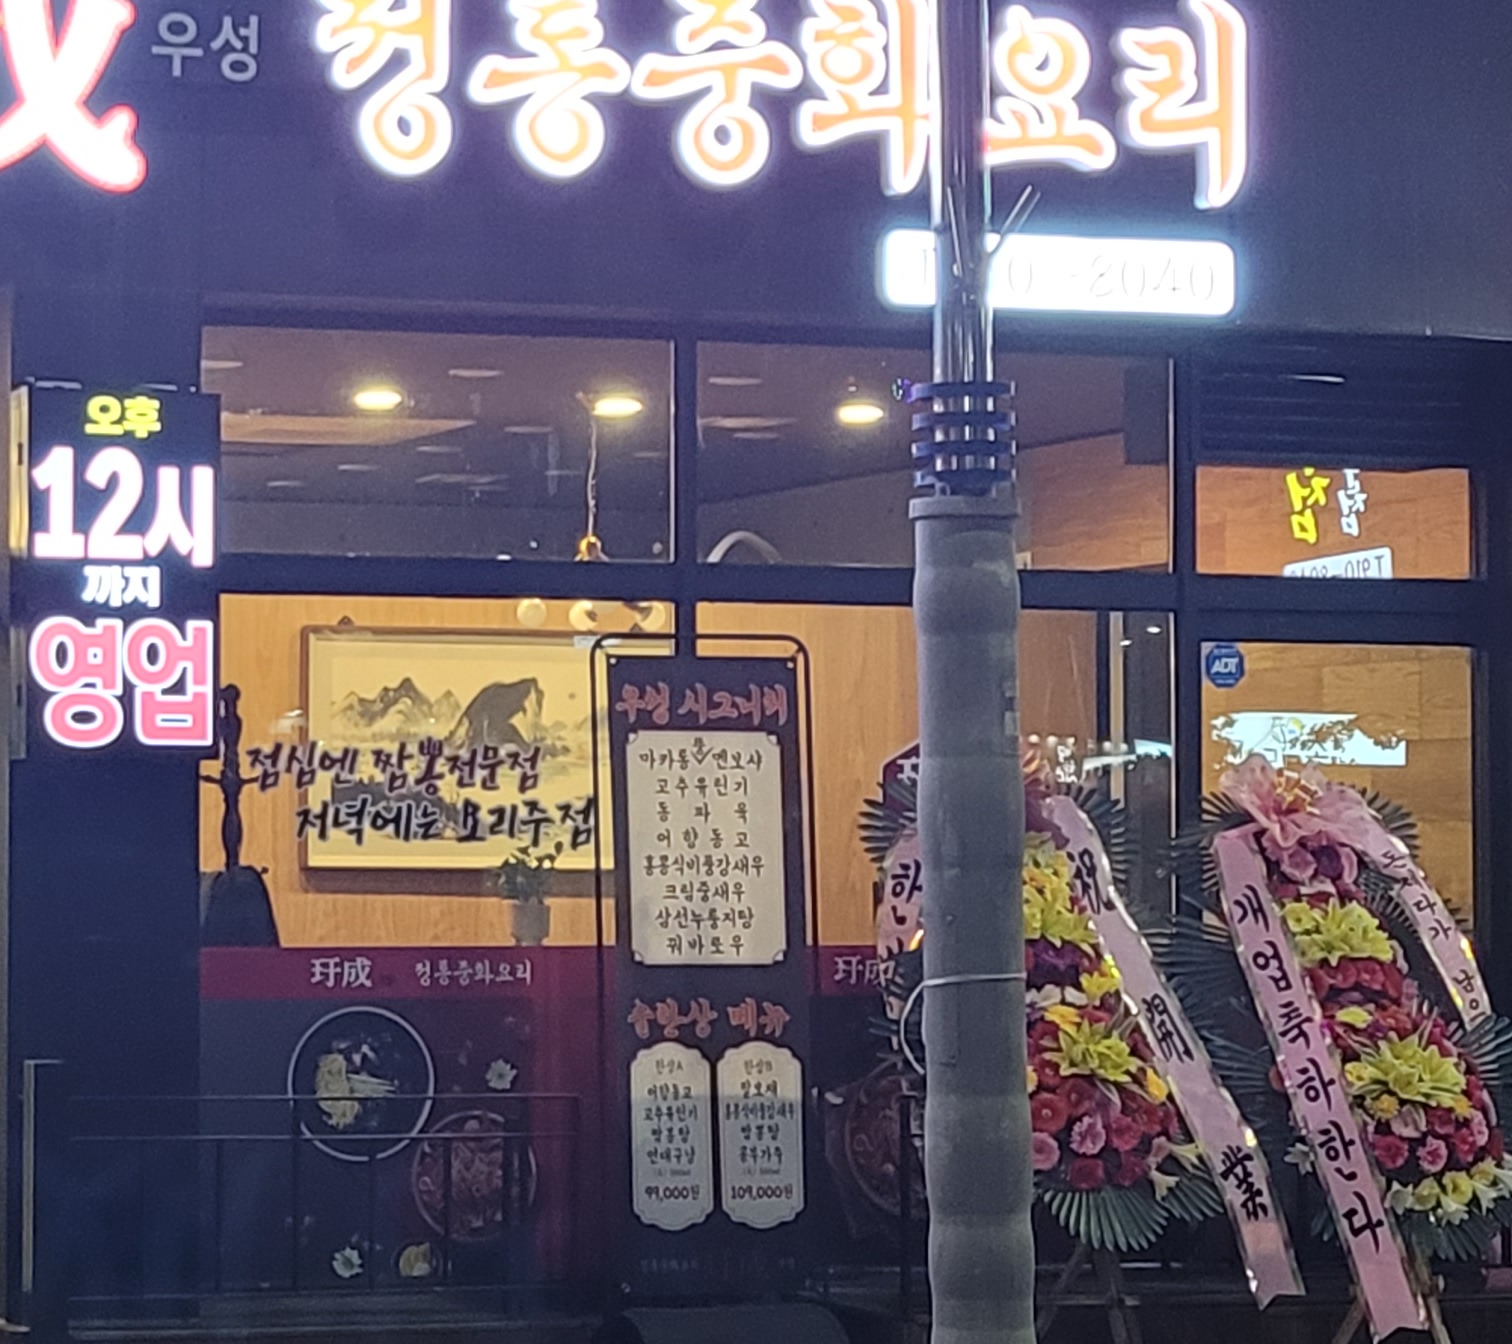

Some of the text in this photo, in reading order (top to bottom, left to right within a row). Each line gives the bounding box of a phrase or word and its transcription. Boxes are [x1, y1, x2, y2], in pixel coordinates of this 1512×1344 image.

[150, 12, 262, 82] 우성
[84, 394, 161, 439] 오후
[32, 445, 216, 568] 12시
[81, 564, 161, 608] 까지
[30, 616, 214, 747] 영업
[1210, 657, 1239, 674] ADT
[615, 681, 670, 725] 우성
[245, 735, 542, 796] 점심엔 짬뽕전문점
[639, 748, 763, 772] 마카롱 멘보샤
[655, 773, 749, 798] 고추유린기
[296, 794, 596, 851] 저녁에는 요리주점
[656, 801, 749, 824] 동파육
[662, 881, 746, 904] 크림중새우
[654, 906, 755, 931] 삼선누룽지탕
[414, 959, 533, 987] 정통중화요리
[726, 997, 791, 1038] 메뉴
[1232, 884, 1386, 1255] 개업축하한다
